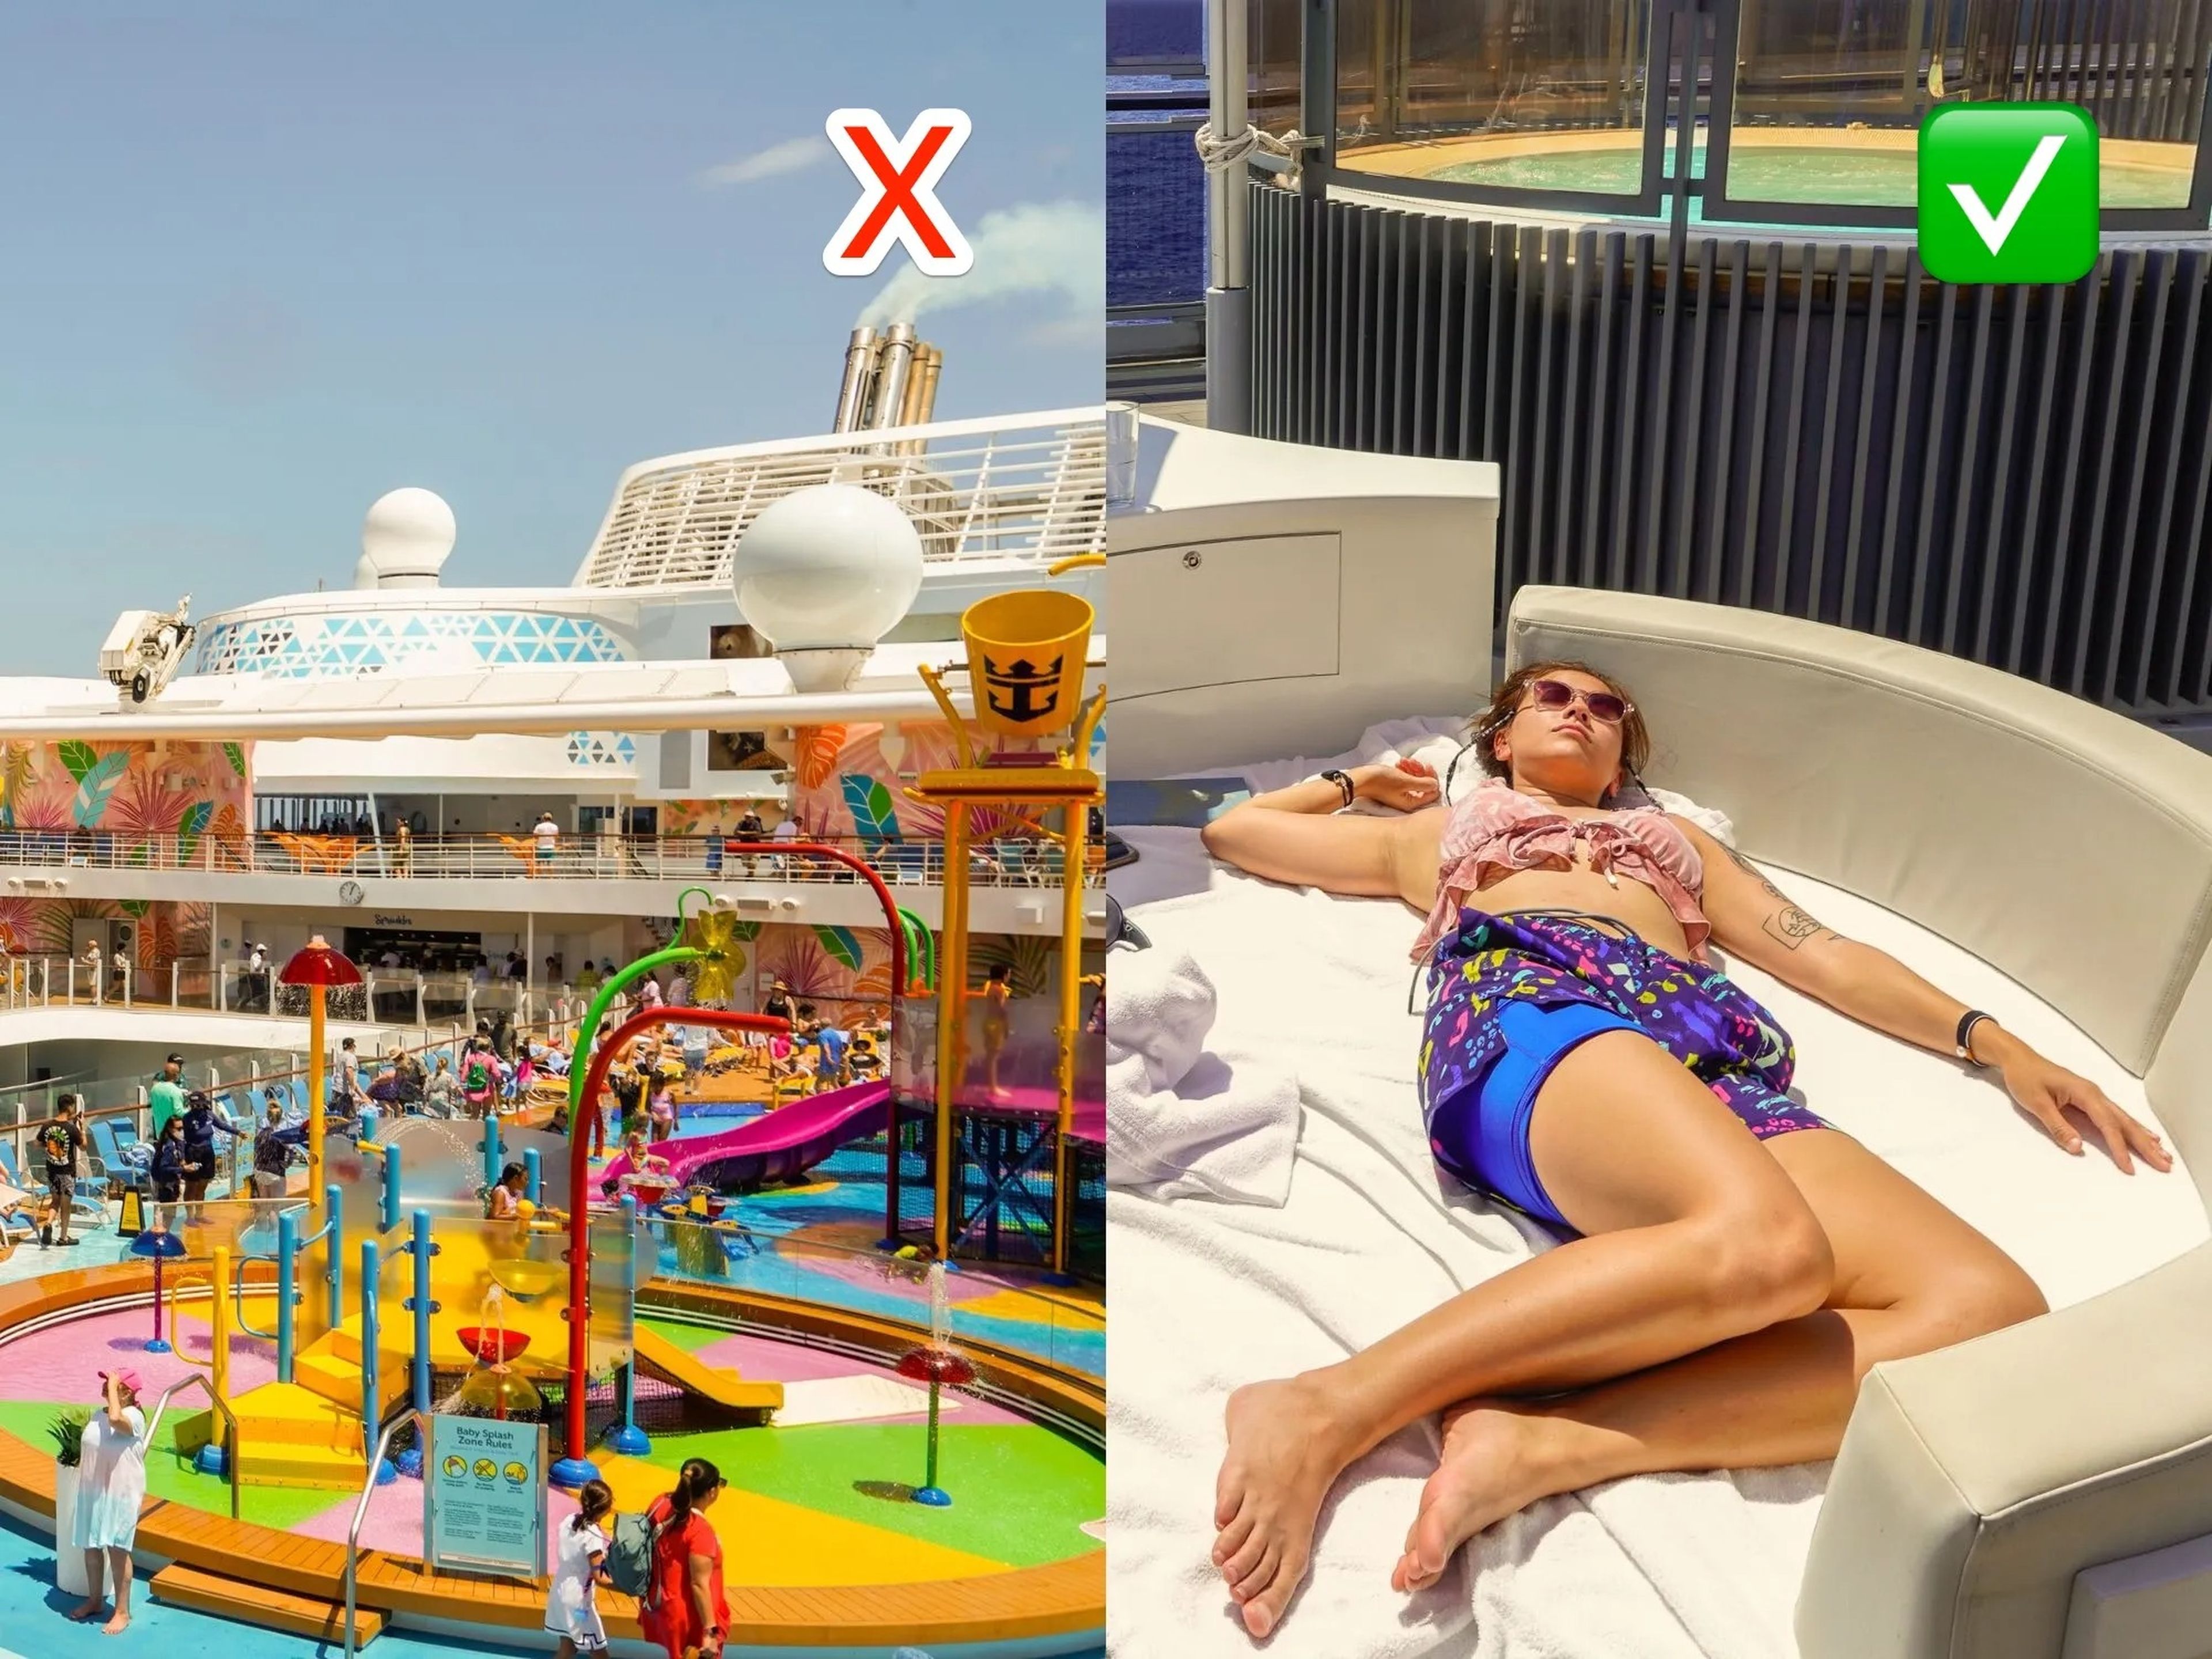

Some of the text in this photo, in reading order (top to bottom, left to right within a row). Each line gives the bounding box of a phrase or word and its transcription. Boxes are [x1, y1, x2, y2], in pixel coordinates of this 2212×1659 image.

[457, 1426, 514, 1440] Baby Splash
[459, 1435, 513, 1449] Zone Rules
